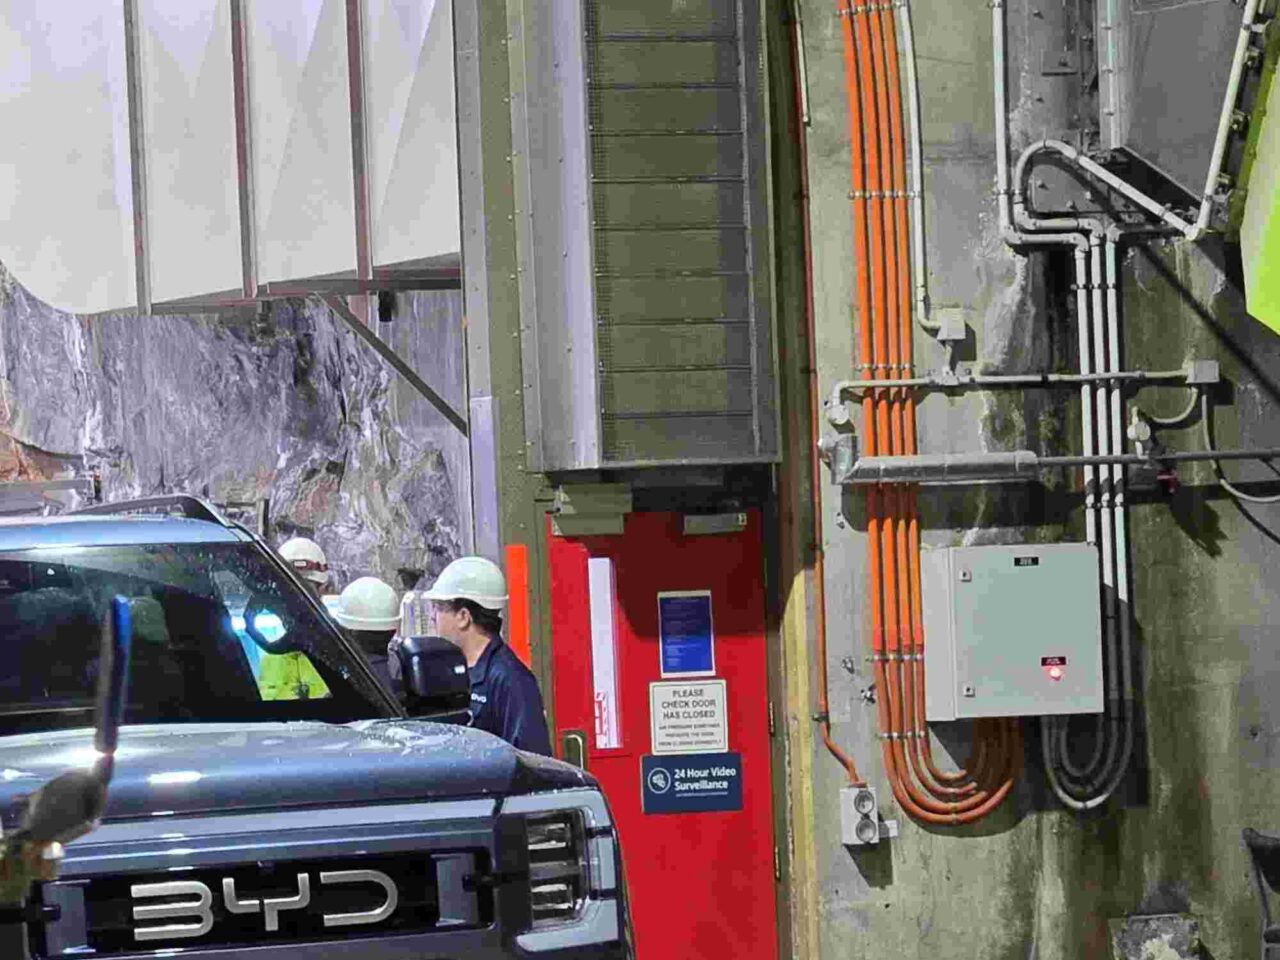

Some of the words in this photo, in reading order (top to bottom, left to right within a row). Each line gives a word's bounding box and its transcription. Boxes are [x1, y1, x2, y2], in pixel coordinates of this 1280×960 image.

[672, 689, 704, 697] PLEASE
[661, 701, 690, 709] CHECK
[692, 699, 716, 707] DOOR
[663, 711, 680, 719] HAS
[682, 709, 715, 719] CLOSED
[674, 768, 685, 778] 24
[687, 768, 709, 777] Hour
[710, 766, 736, 777] Video
[674, 780, 729, 791] Surveillance
[131, 869, 398, 941] BYD
